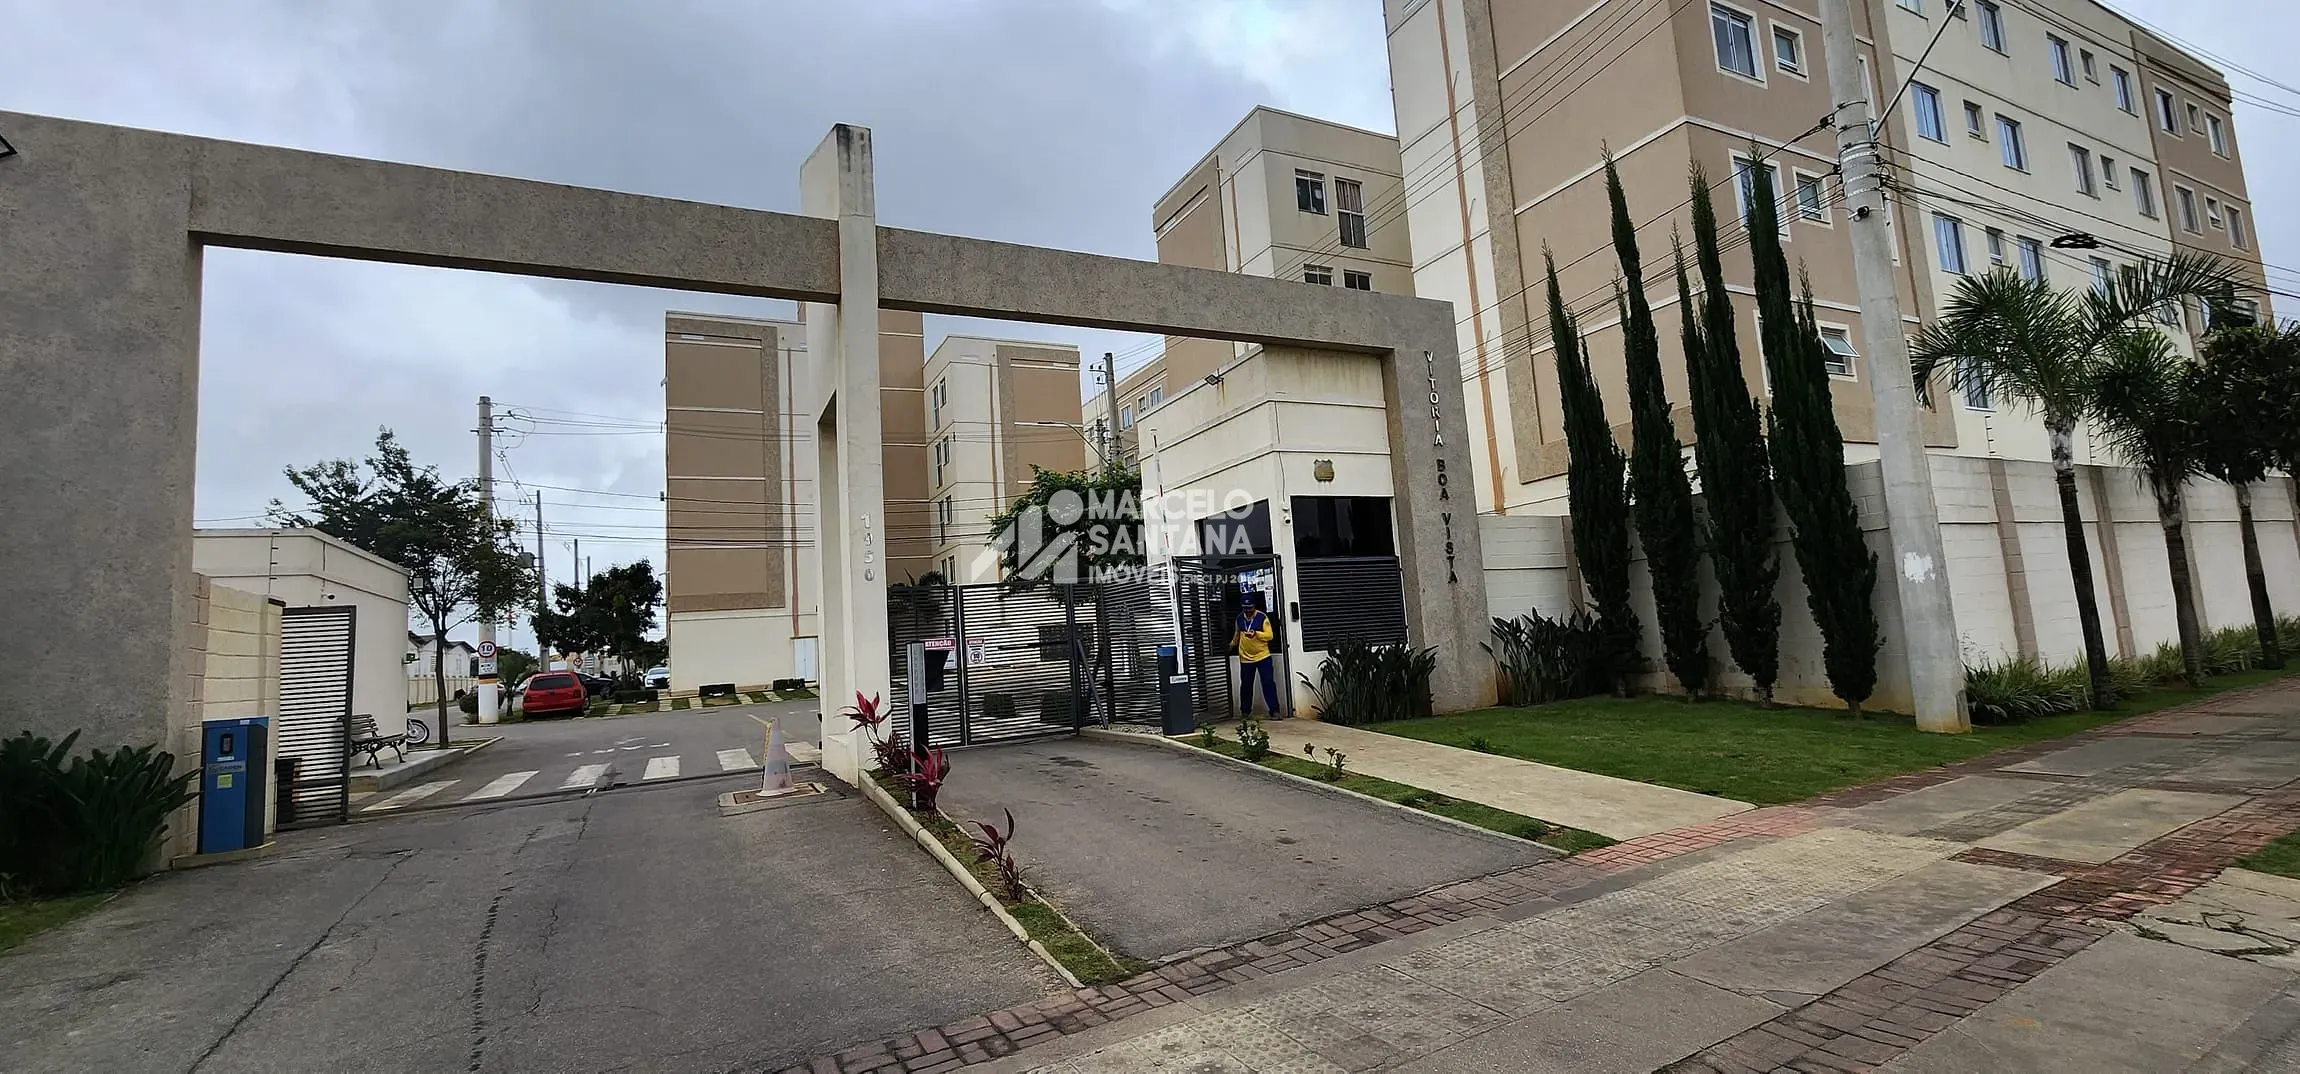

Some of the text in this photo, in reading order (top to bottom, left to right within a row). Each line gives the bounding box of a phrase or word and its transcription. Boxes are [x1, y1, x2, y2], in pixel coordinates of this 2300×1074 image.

[1424, 350, 1458, 584] VITORIA BOA VISTA
